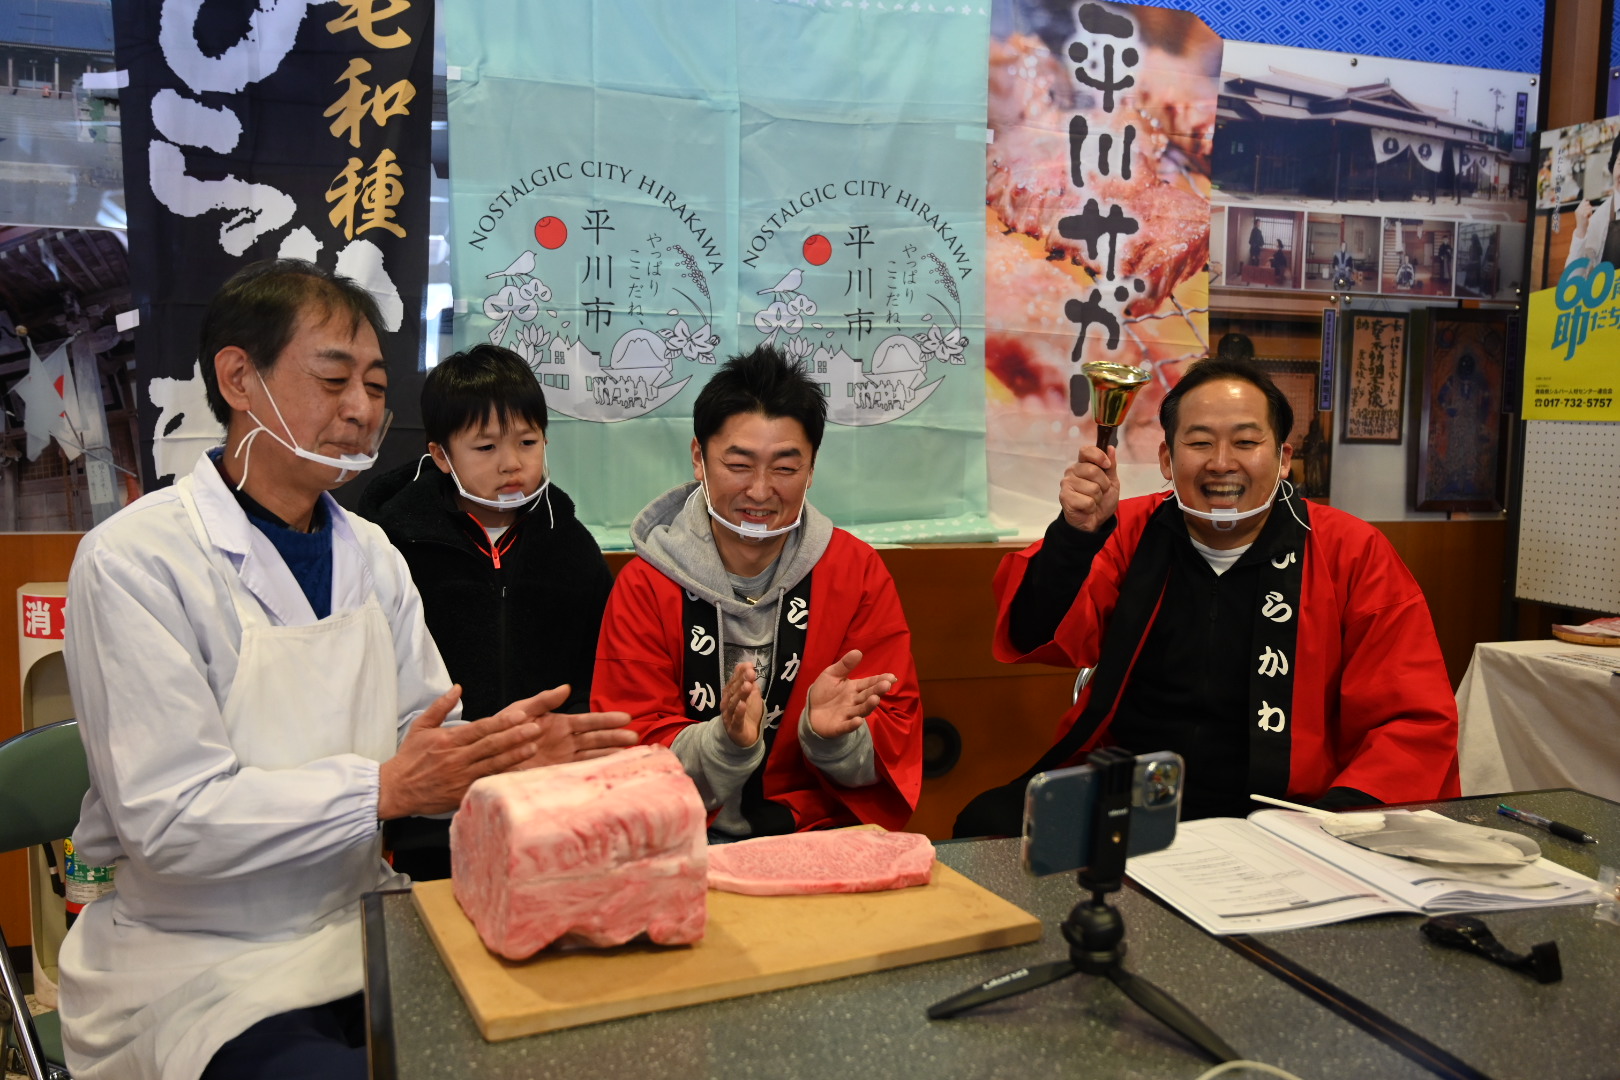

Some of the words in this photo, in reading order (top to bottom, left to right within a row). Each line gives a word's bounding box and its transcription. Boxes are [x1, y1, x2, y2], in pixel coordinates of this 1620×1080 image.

[468, 162, 573, 251] NOSTALGIC
[580, 161, 633, 183] CITY
[638, 175, 724, 275] HIRAKAWA
[742, 183, 837, 269] NOSTALGIC
[844, 180, 892, 199] CITY
[896, 190, 972, 280] HIRAKAWA
[581, 209, 615, 334] 平川市
[628, 249, 644, 326] ここだね、
[646, 232, 663, 297] やっぱり
[843, 224, 875, 342] 平川市
[886, 260, 901, 332] ここだね、
[902, 243, 918, 305] やっぱり
[25, 600, 66, 636] 消
